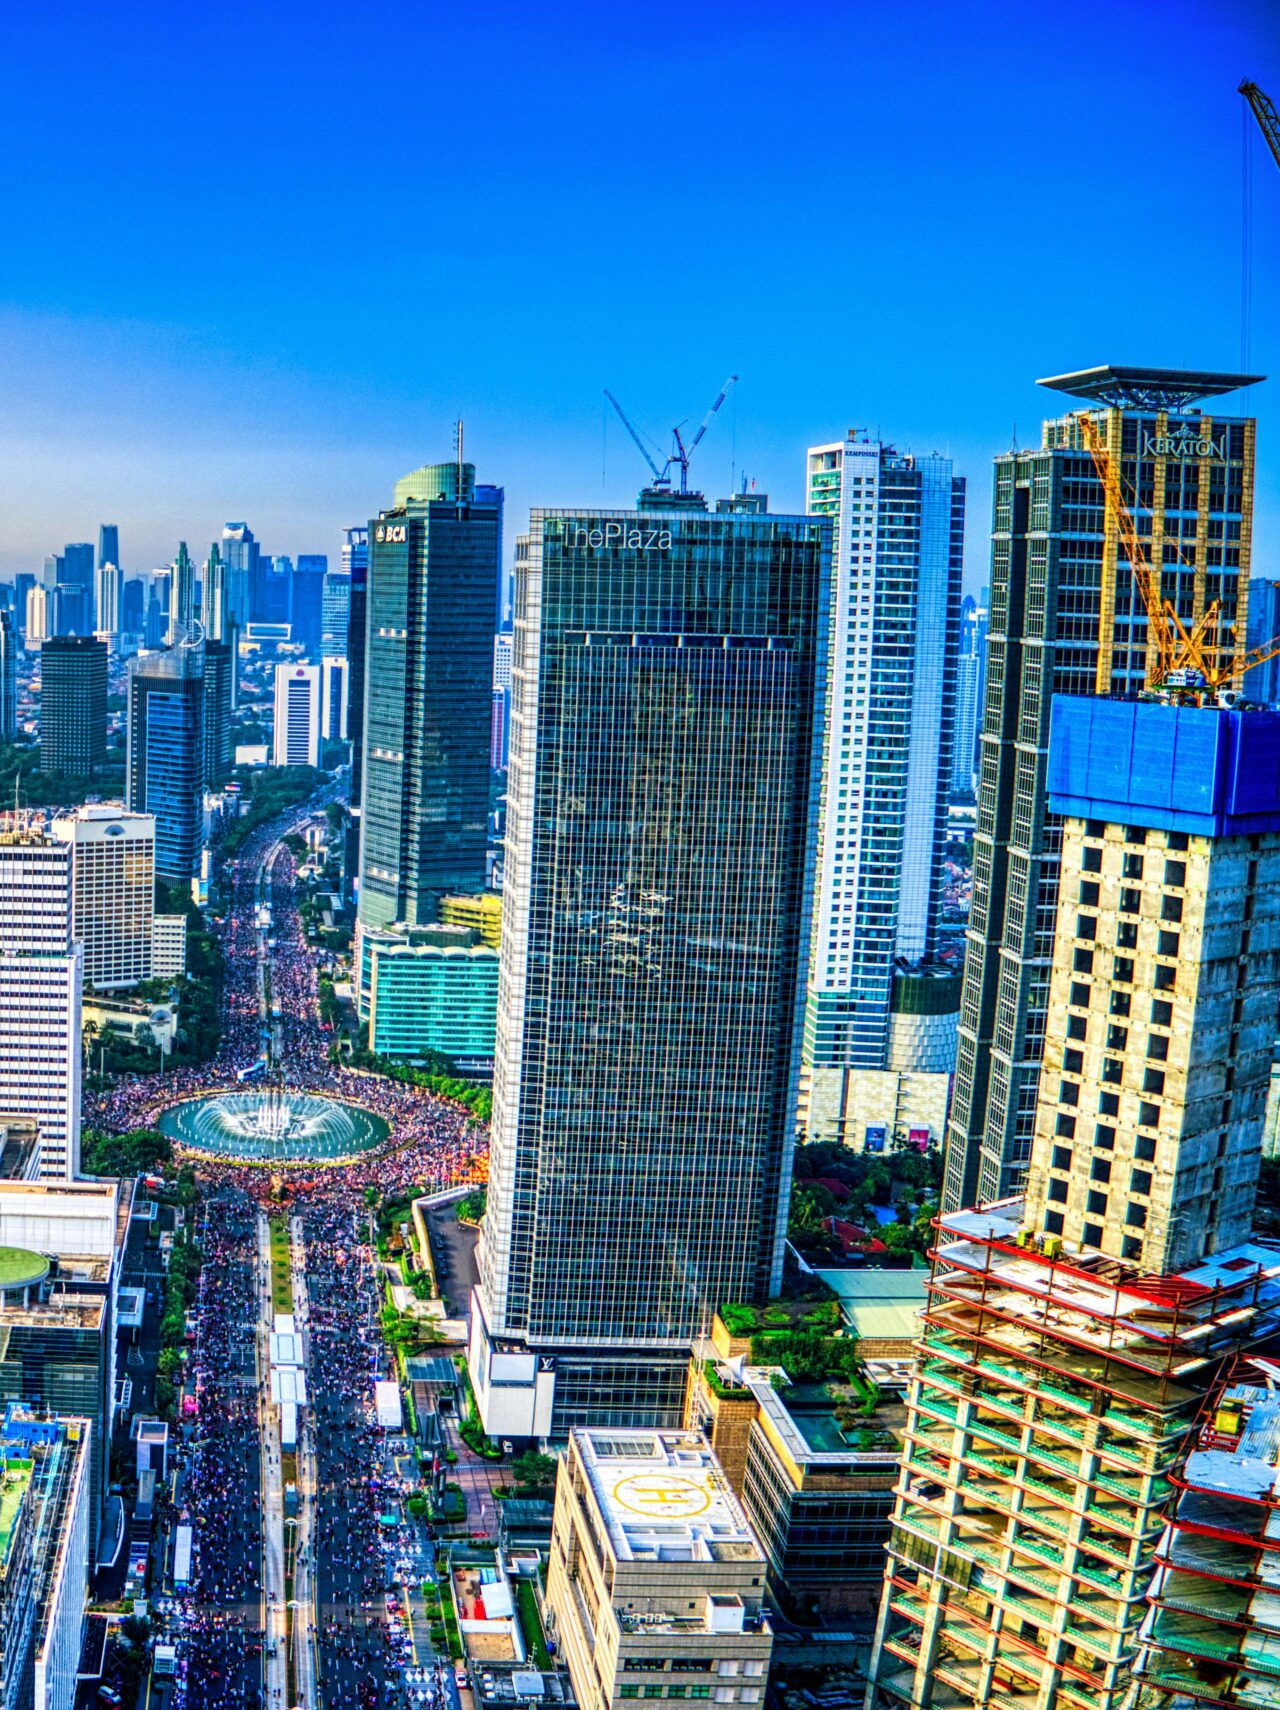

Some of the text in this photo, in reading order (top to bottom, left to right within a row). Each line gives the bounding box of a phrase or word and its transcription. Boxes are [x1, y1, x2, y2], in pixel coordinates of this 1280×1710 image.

[1142, 429, 1225, 462] KERATON
[385, 526, 406, 542] BCA
[560, 521, 672, 549] ThePlaza
